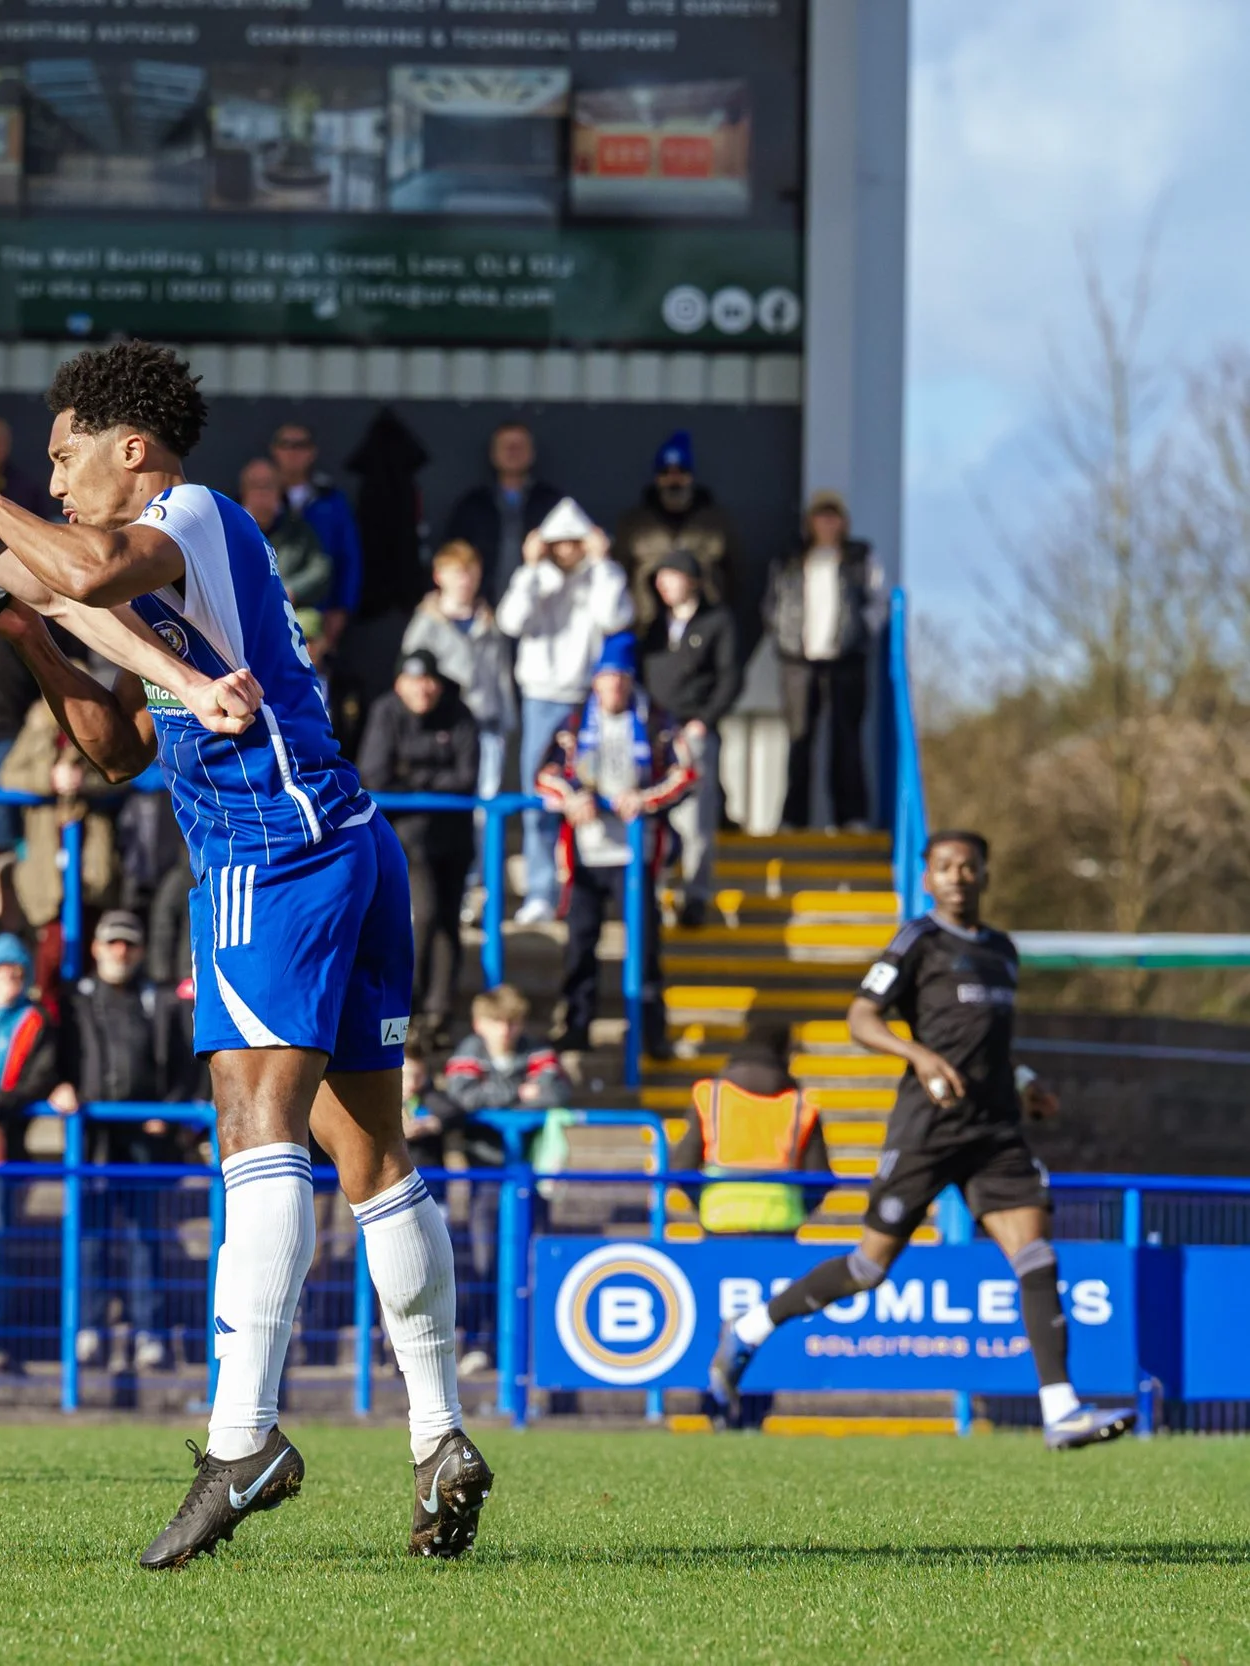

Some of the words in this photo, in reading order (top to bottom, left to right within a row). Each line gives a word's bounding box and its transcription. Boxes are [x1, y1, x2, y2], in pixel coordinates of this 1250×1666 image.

[97, 22, 199, 44] AUTOCAD
[247, 25, 425, 47] COMMISSIONING
[451, 28, 571, 49] TECHNICAL
[578, 29, 676, 51] SUPPORT
[1, 246, 42, 270] The
[264, 251, 319, 276] High
[597, 1286, 653, 1342] B
[805, 1334, 970, 1357] SOLICITORS
[976, 1335, 1033, 1358] LLP
